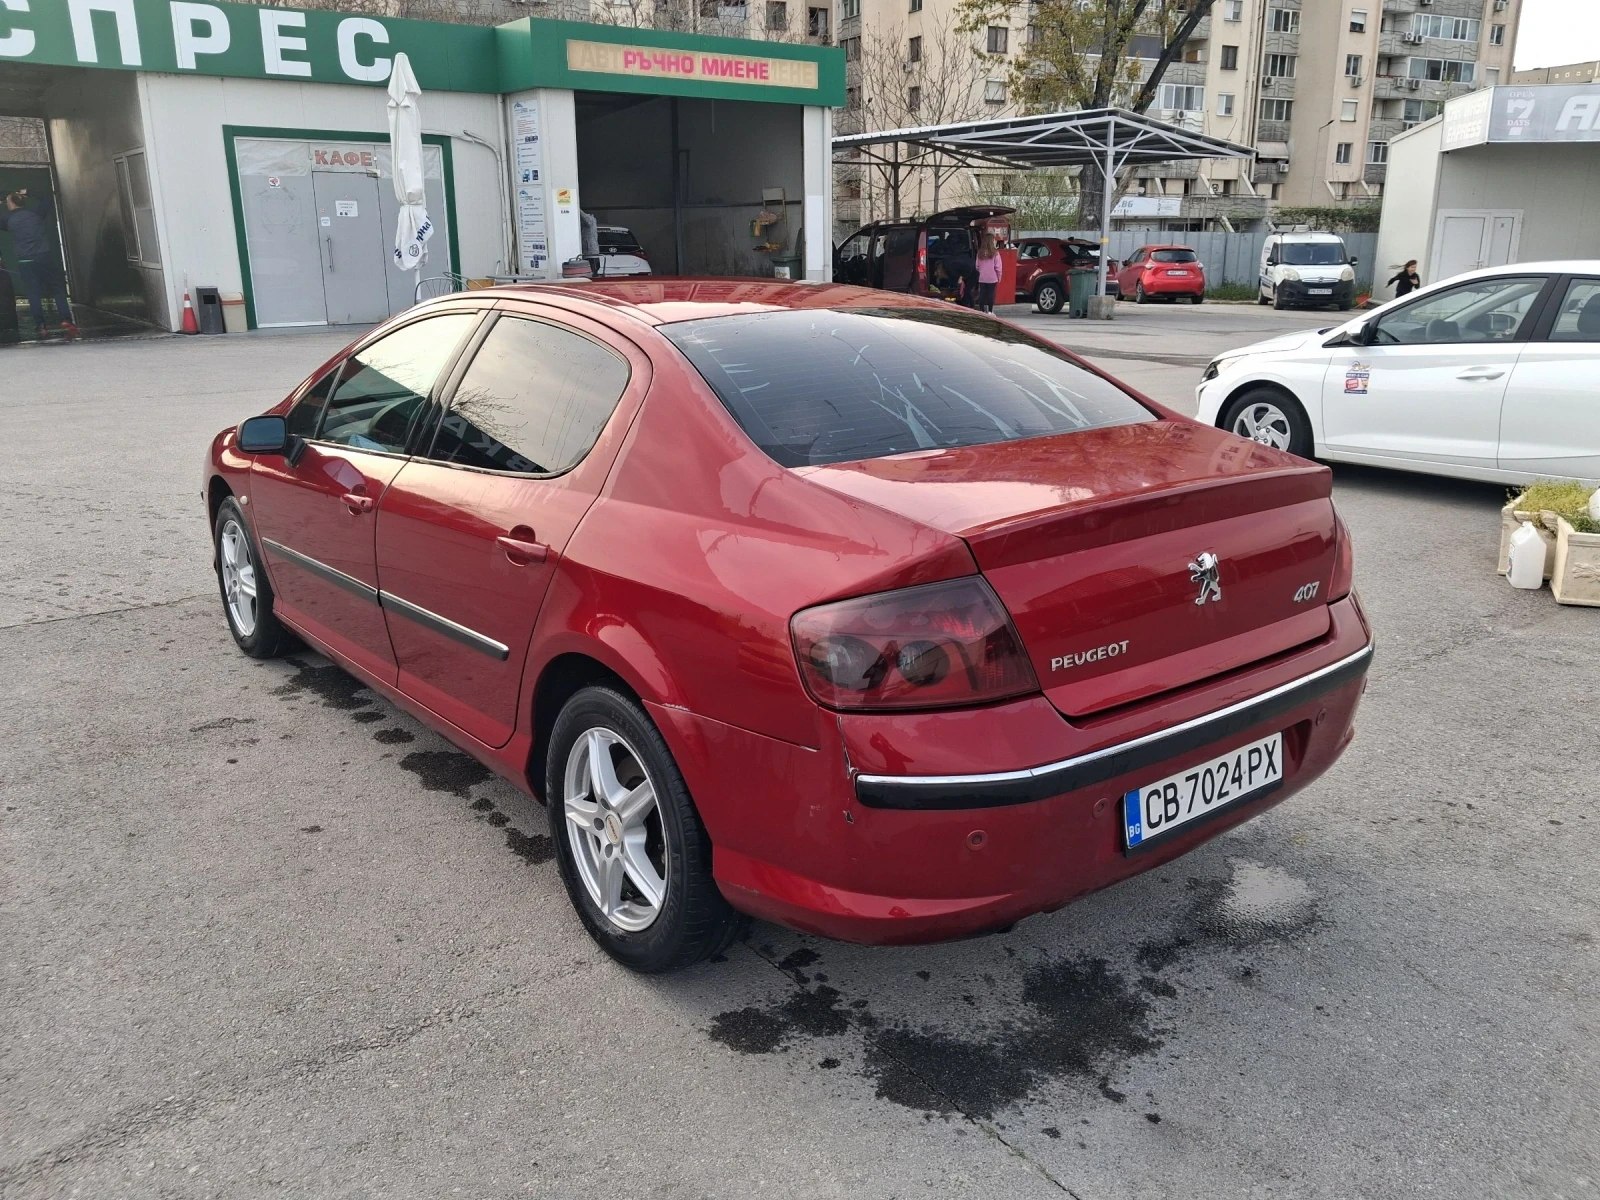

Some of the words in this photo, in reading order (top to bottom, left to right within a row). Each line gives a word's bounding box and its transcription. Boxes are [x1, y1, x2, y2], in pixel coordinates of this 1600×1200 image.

[623, 50, 695, 74] РЪЧНО
[701, 57, 769, 80] МИЕНЕ
[314, 150, 372, 166] КАФЕ
[1293, 581, 1320, 603] 407
[1051, 640, 1130, 671] PEUGEOT
[1145, 782, 1180, 829] CB
[1185, 754, 1243, 814] 7024
[1248, 740, 1277, 786] PX
[1129, 823, 1141, 837] BG
